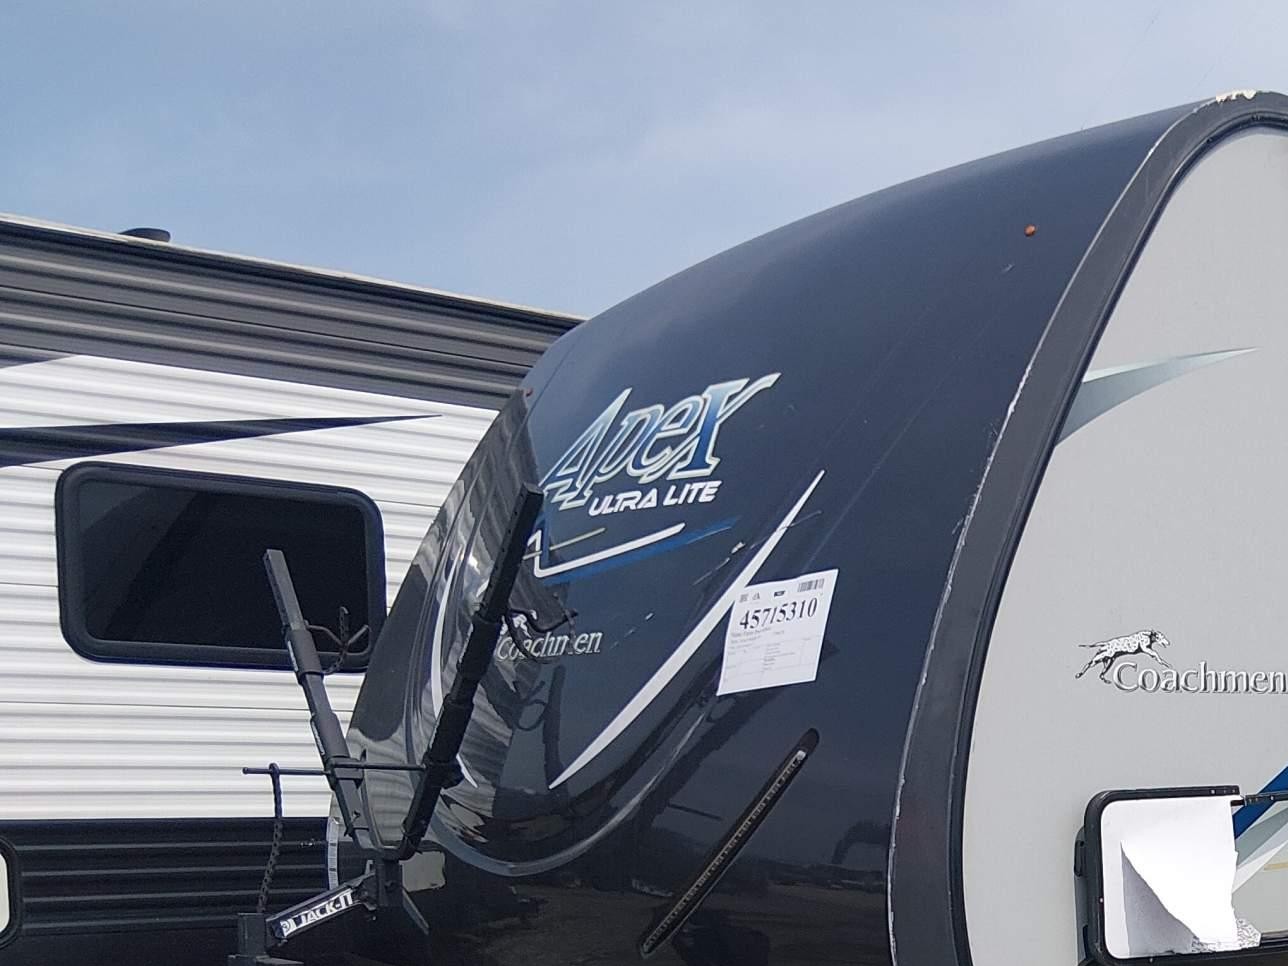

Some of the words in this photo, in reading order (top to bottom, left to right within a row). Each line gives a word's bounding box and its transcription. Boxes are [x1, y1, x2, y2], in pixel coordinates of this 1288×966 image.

[538, 373, 782, 511] Apex
[588, 488, 658, 517] ULTRA
[663, 480, 722, 506] LITE
[739, 597, 818, 630] 45715310
[1113, 661, 1288, 694] Coachmen
[299, 892, 354, 925] JACK-IT
